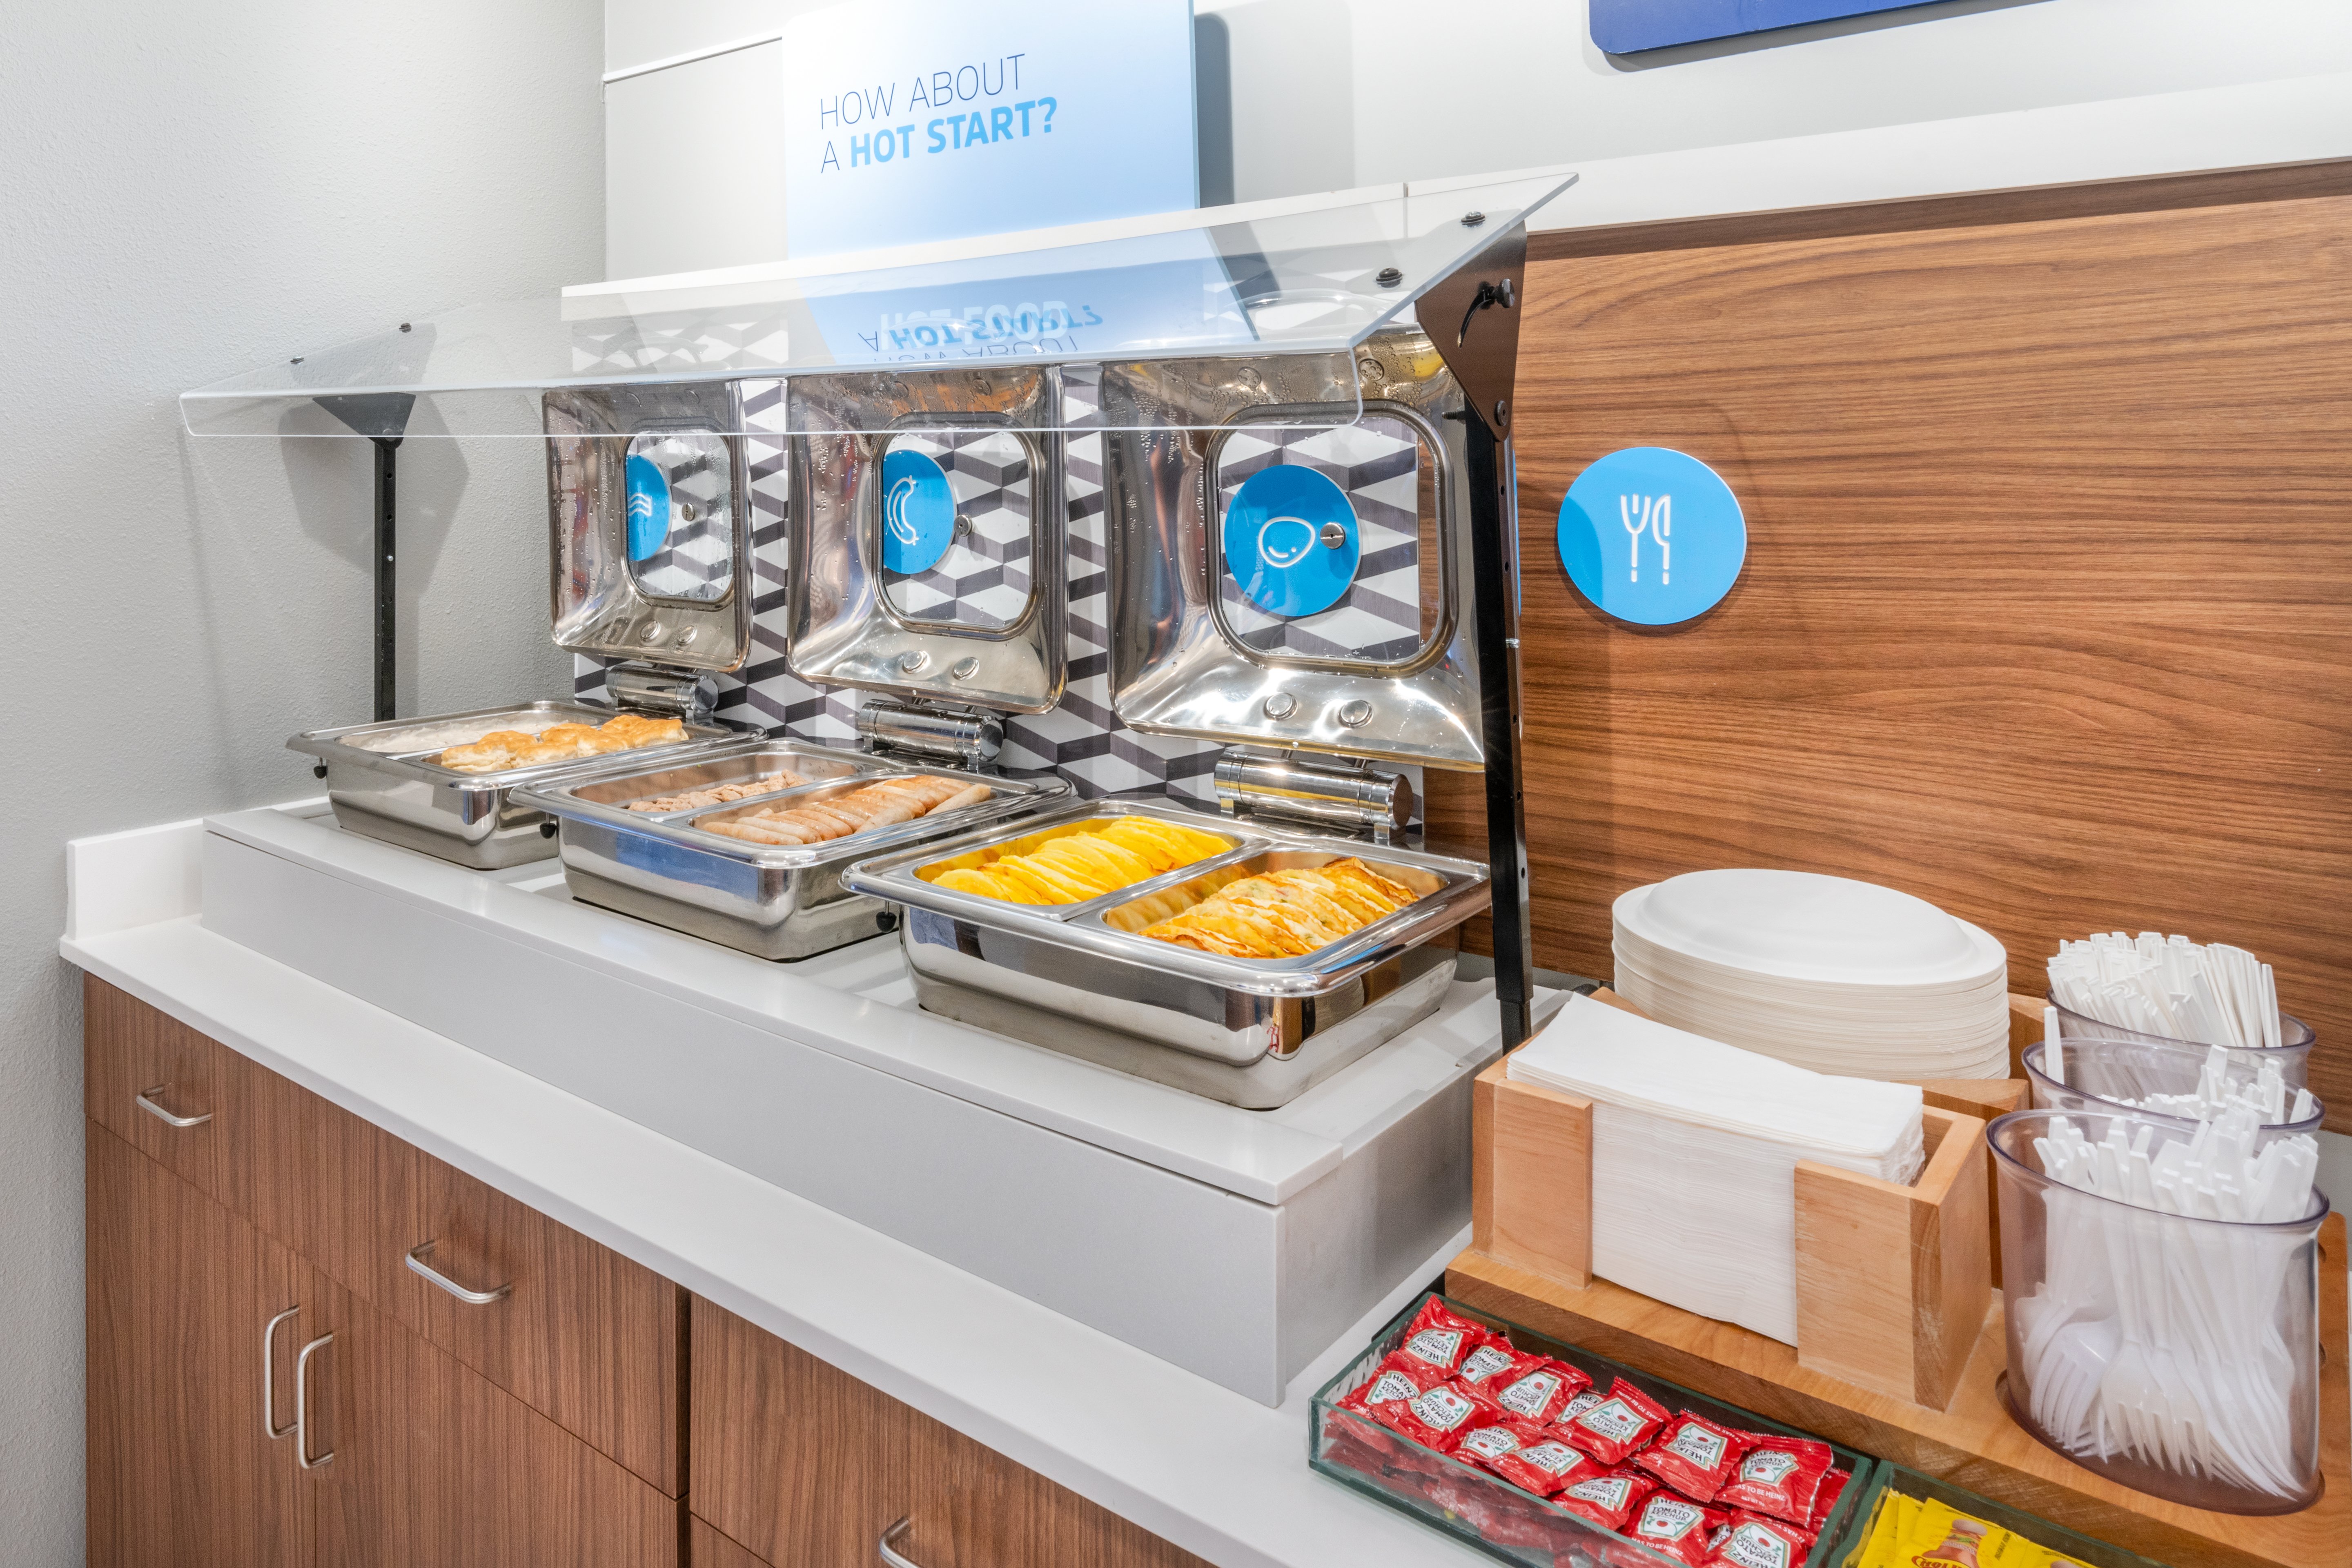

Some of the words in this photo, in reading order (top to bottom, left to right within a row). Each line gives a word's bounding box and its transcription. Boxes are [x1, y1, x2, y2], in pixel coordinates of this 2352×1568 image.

[821, 83, 895, 129] HOW
[909, 53, 1025, 112] ABOUT
[821, 141, 840, 173] A
[851, 125, 915, 167] HOT
[927, 96, 1057, 154] START?
[964, 301, 1069, 344] FOOD
[1417, 1337, 1447, 1354] TOMATO
[1421, 1335, 1449, 1349] KETCHUP
[1413, 1344, 1439, 1361] HEINZ
[1484, 1350, 1506, 1363] HEINZ
[1472, 1354, 1499, 1369] TOMATO
[1381, 1386, 1402, 1400] KETCH
[1383, 1380, 1408, 1400] TOMAT
[1393, 1374, 1416, 1398] HEINZ
[1428, 1396, 1454, 1419] KETCHUP
[1581, 1395, 1598, 1404] HEI
[1415, 1405, 1439, 1425] HEINZ
[1423, 1398, 1451, 1423] TOMATO
[1646, 1411, 1659, 1420] HAS
[1599, 1414, 1628, 1431] KETCHUP
[1722, 1429, 1735, 1438] HAS
[1575, 1492, 1606, 1502] HEINZ
[1765, 1490, 1785, 1501] HEINZ
[1653, 1507, 1690, 1518] TOMATO
[1660, 1499, 1693, 1511] HEINZ
[1651, 1511, 1686, 1521] KETCHUP
[1783, 1527, 1797, 1537] HAS
[1663, 1544, 1684, 1556] HEINZ
[1737, 1539, 1777, 1565] TOMATO
[1741, 1537, 1778, 1559] KETCHUP
[1733, 1551, 1768, 1568] HEINZ
